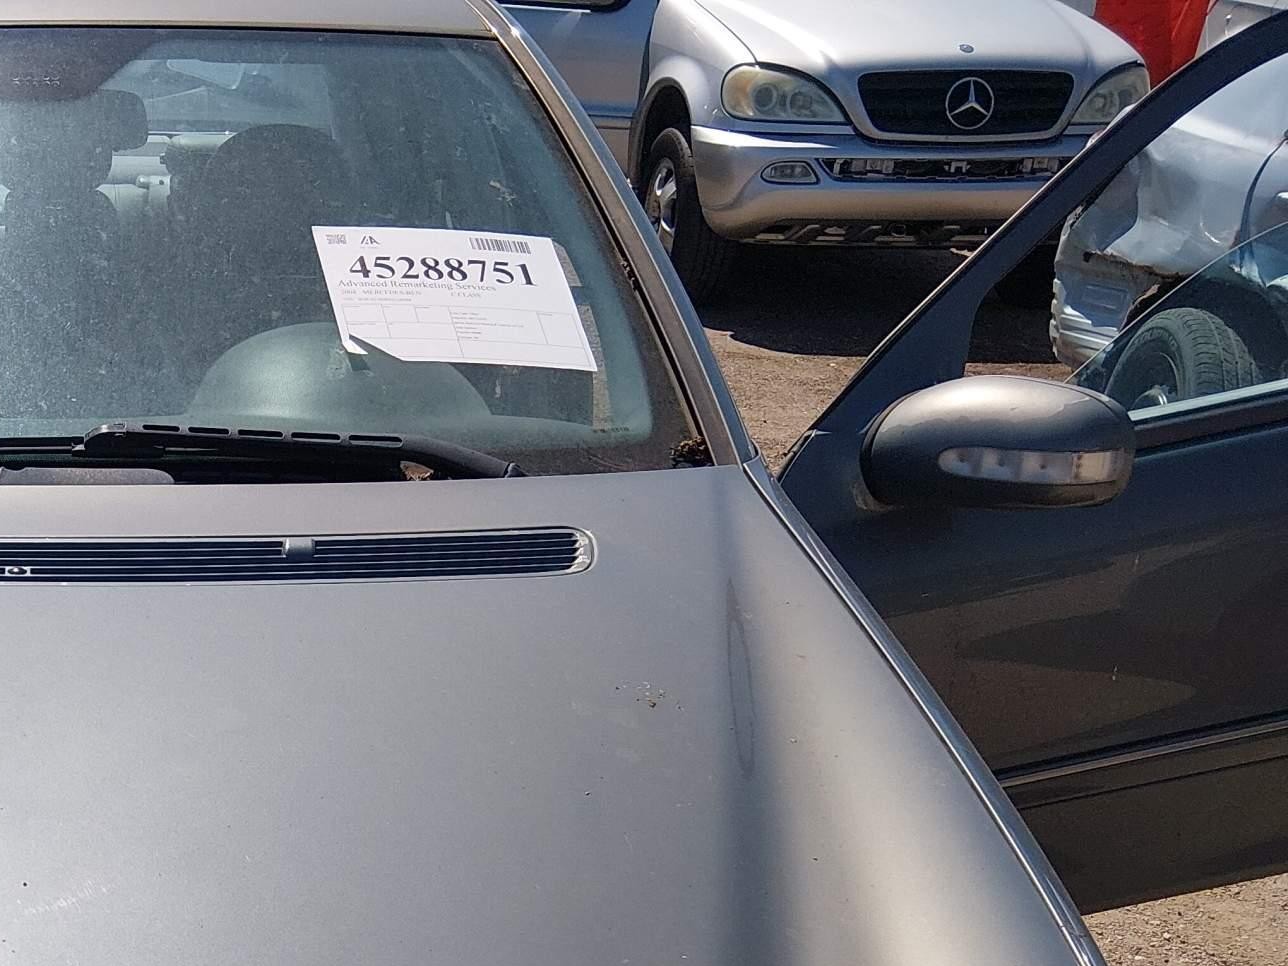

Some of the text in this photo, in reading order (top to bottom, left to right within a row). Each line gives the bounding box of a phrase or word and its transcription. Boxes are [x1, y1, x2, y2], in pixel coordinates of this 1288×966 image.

[349, 255, 538, 286] 45288751
[338, 279, 497, 292] Advanced Remarketing Services
